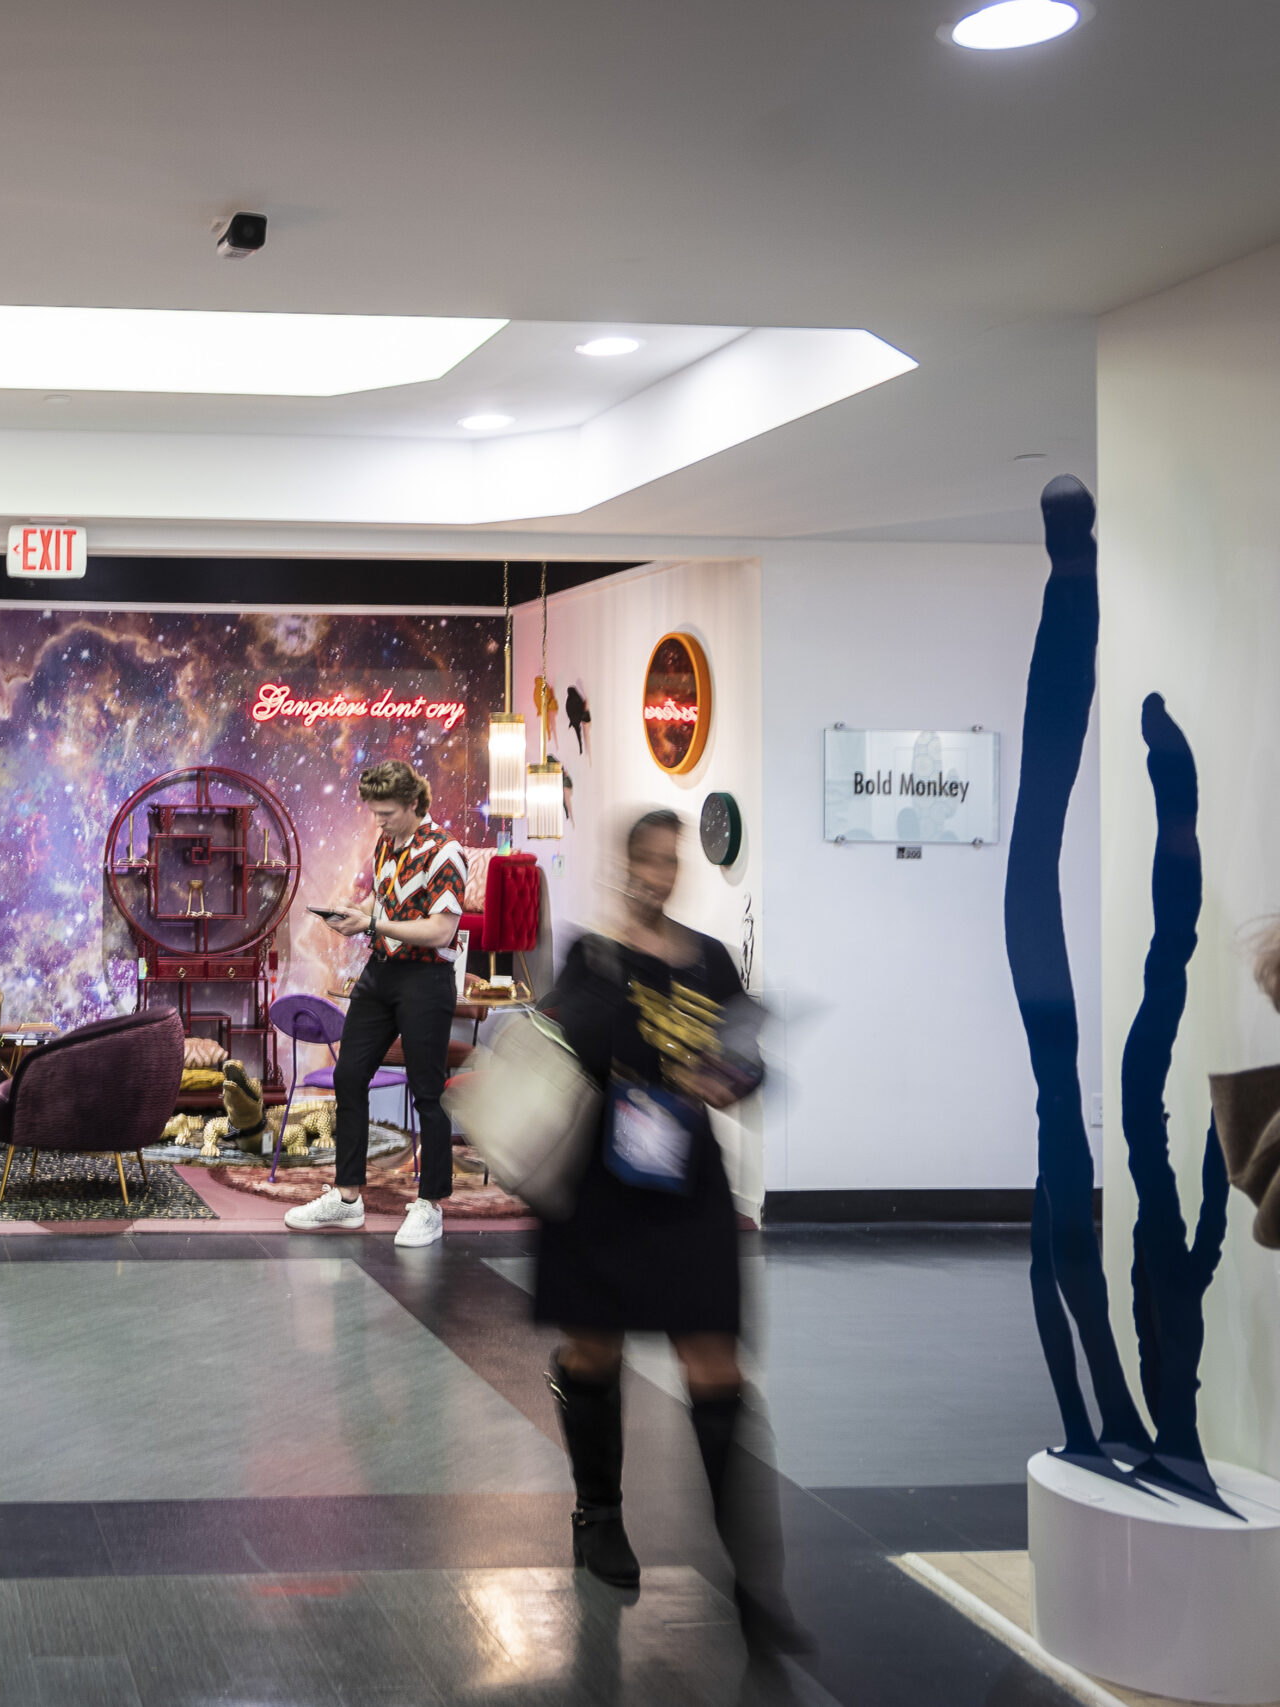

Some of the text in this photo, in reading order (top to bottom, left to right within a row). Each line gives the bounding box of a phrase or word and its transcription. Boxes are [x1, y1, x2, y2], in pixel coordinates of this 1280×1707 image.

[22, 528, 77, 571] EXIT
[252, 684, 368, 727] Gangsters
[425, 701, 466, 729] cry
[854, 770, 969, 803] Bold Monkey
